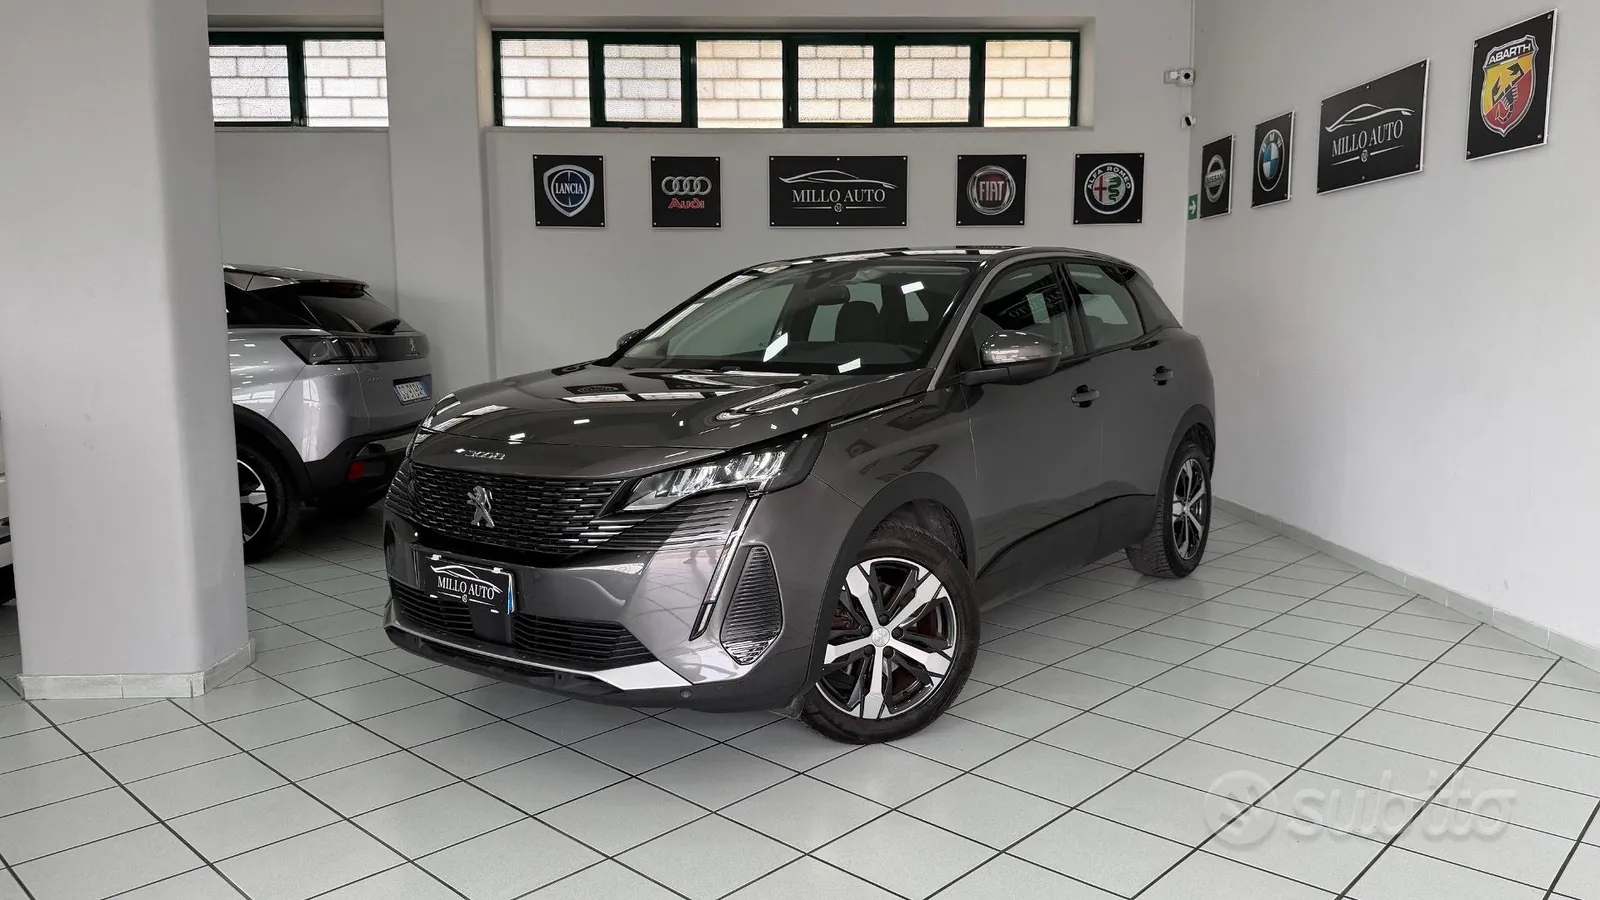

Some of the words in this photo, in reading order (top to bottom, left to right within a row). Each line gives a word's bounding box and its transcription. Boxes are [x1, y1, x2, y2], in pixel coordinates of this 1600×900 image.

[1488, 43, 1531, 64] ABARTH
[1332, 130, 1367, 157] MILLO
[1368, 120, 1403, 146] AUTO
[1087, 169, 1103, 189] ALFA
[1106, 166, 1131, 189] ROMEO
[555, 182, 584, 195] LANCIA
[792, 189, 840, 203] MILLO
[843, 189, 886, 203] AUTO
[979, 181, 1005, 201] FIAT
[668, 198, 705, 209] Audi
[437, 576, 467, 593] MILLO
[468, 584, 495, 600] AUTO
